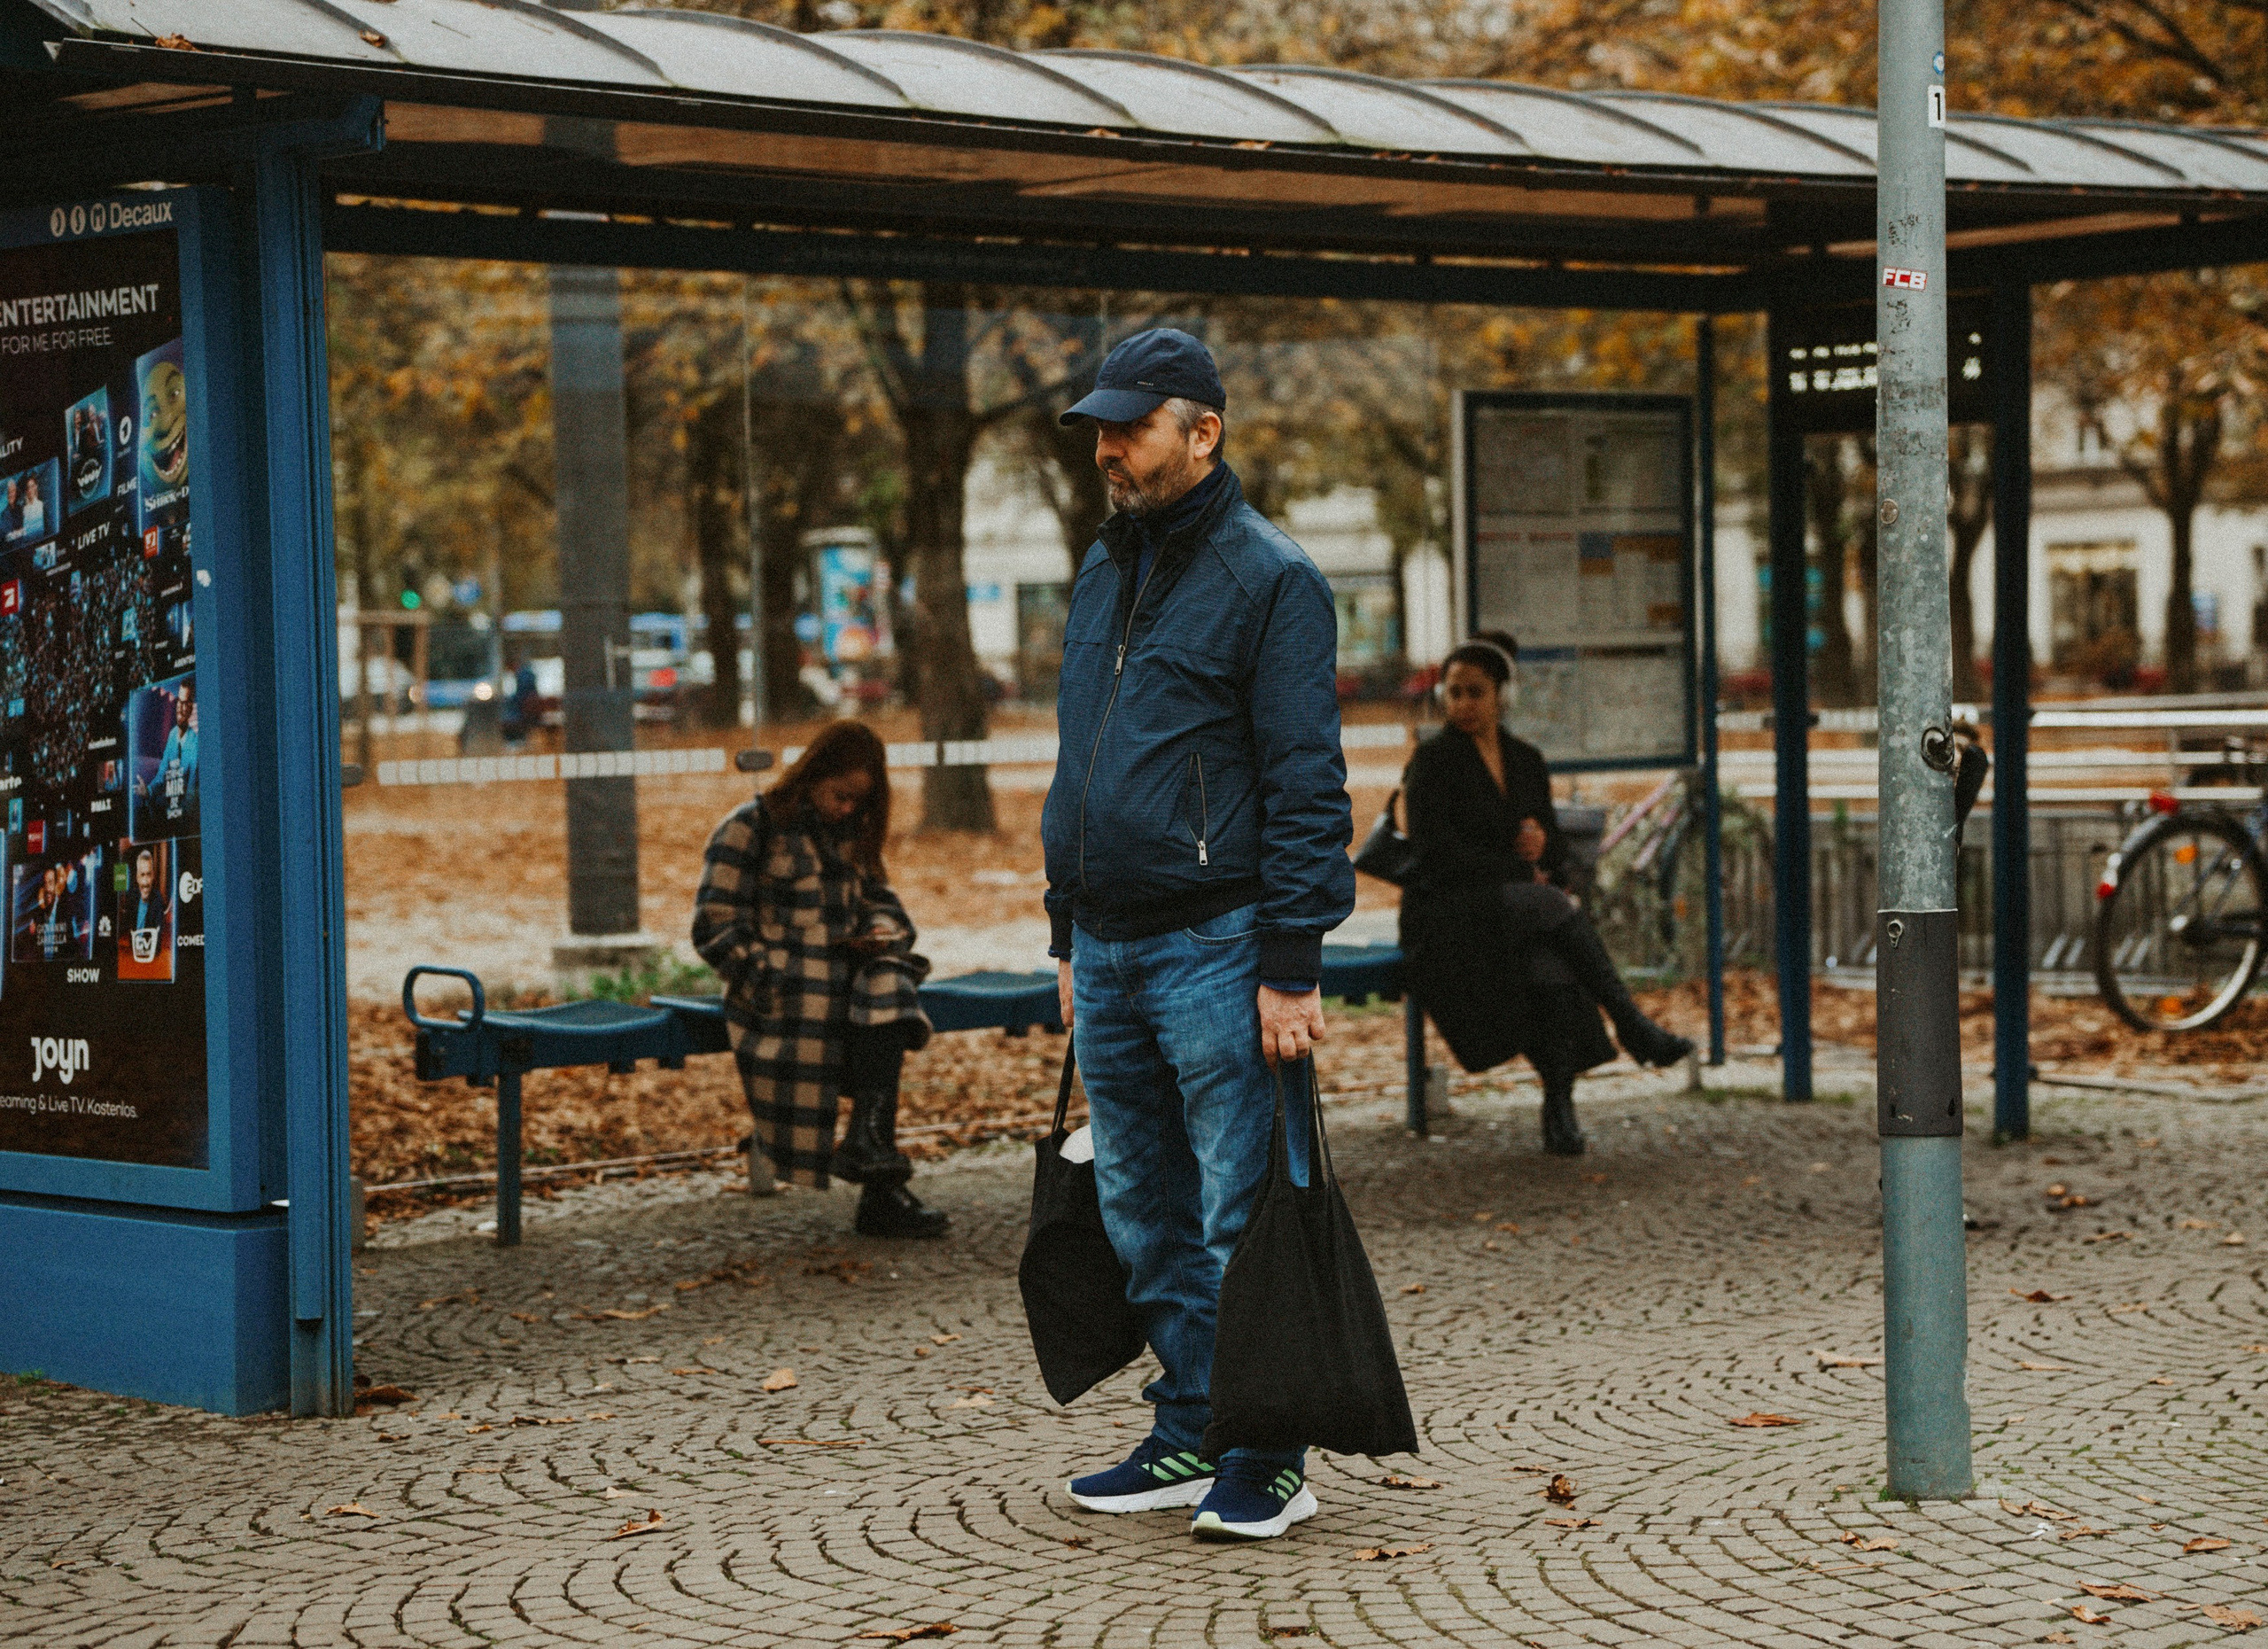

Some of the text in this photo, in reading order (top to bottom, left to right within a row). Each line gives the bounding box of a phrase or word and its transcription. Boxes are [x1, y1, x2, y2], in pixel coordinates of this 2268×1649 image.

[1934, 92, 1941, 121] 1
[1883, 268, 1927, 291] FCB
[2, 335, 30, 354] FOR
[52, 331, 76, 349] FOR
[97, 521, 111, 540] TV
[66, 968, 100, 983] SHOW
[38, 1093, 47, 1110] &
[49, 1096, 69, 1113] Live
